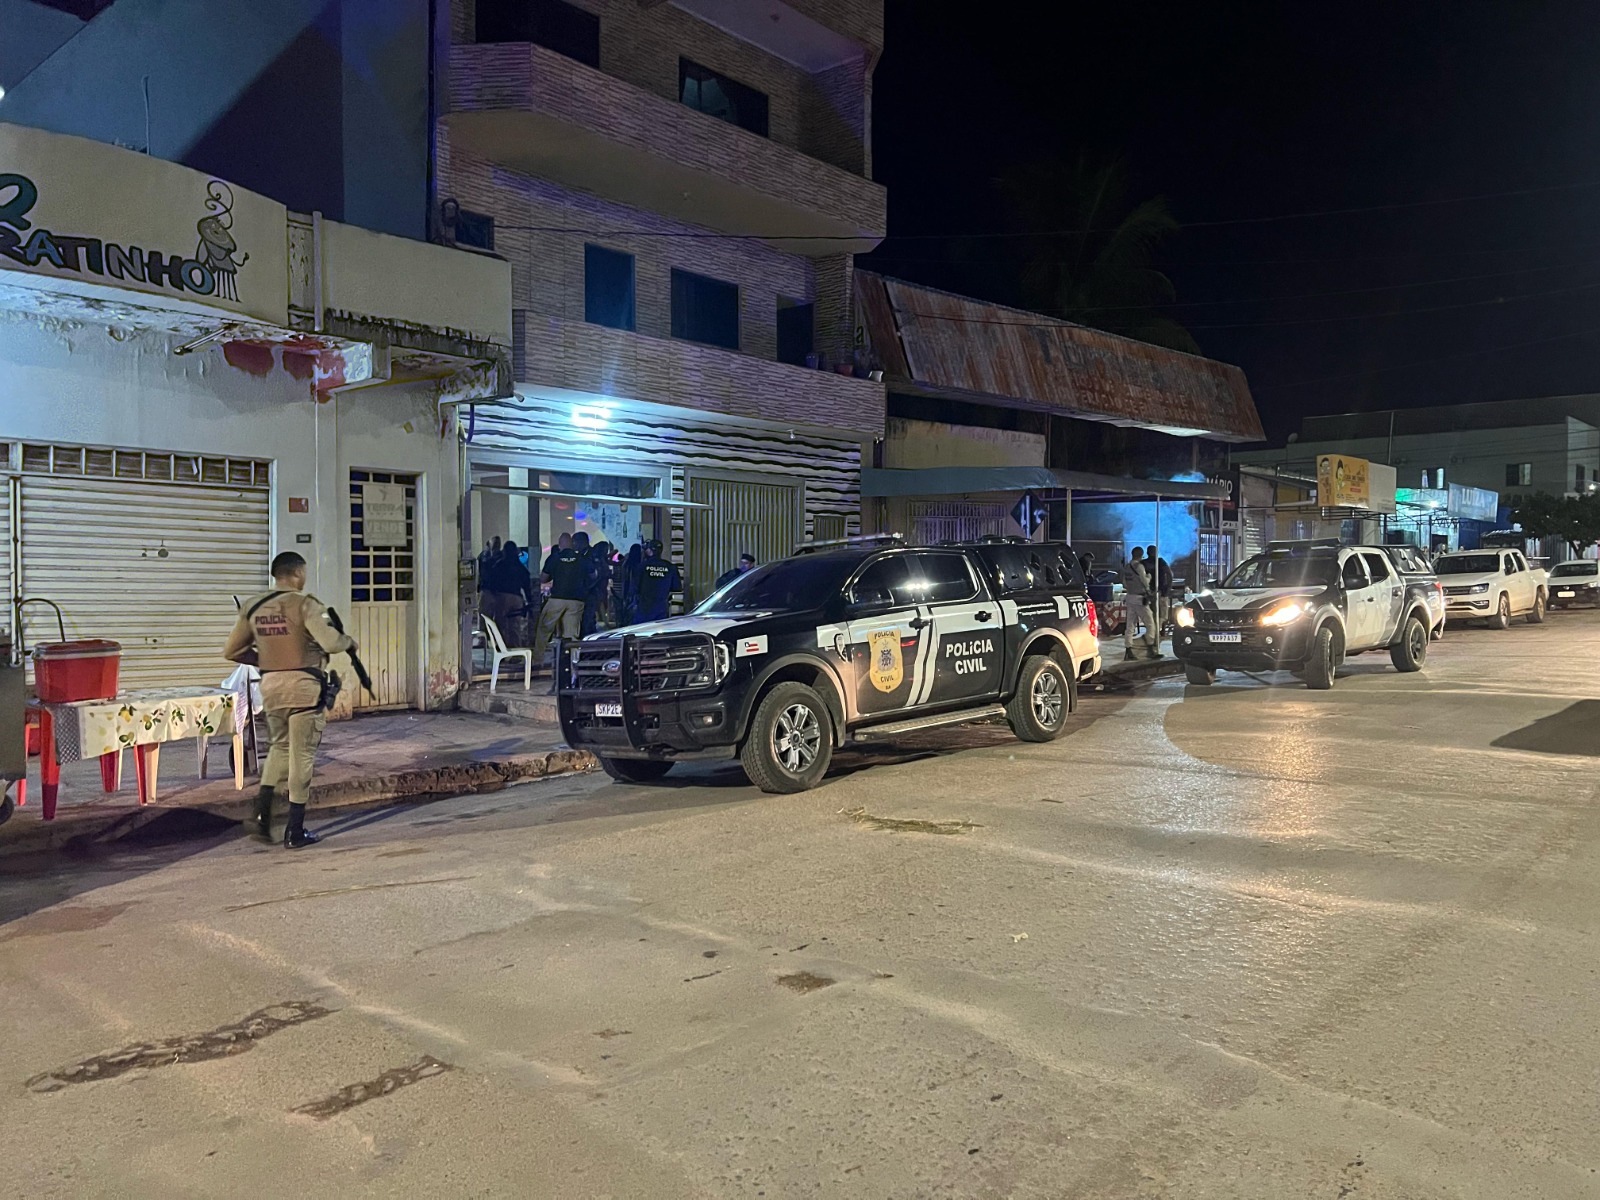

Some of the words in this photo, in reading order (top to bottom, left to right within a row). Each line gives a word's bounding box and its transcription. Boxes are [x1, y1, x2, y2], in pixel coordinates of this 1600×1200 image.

[256, 626, 288, 636] MILITAR
[955, 657, 987, 675] CIVIL
[880, 675, 894, 683] CIVIL
